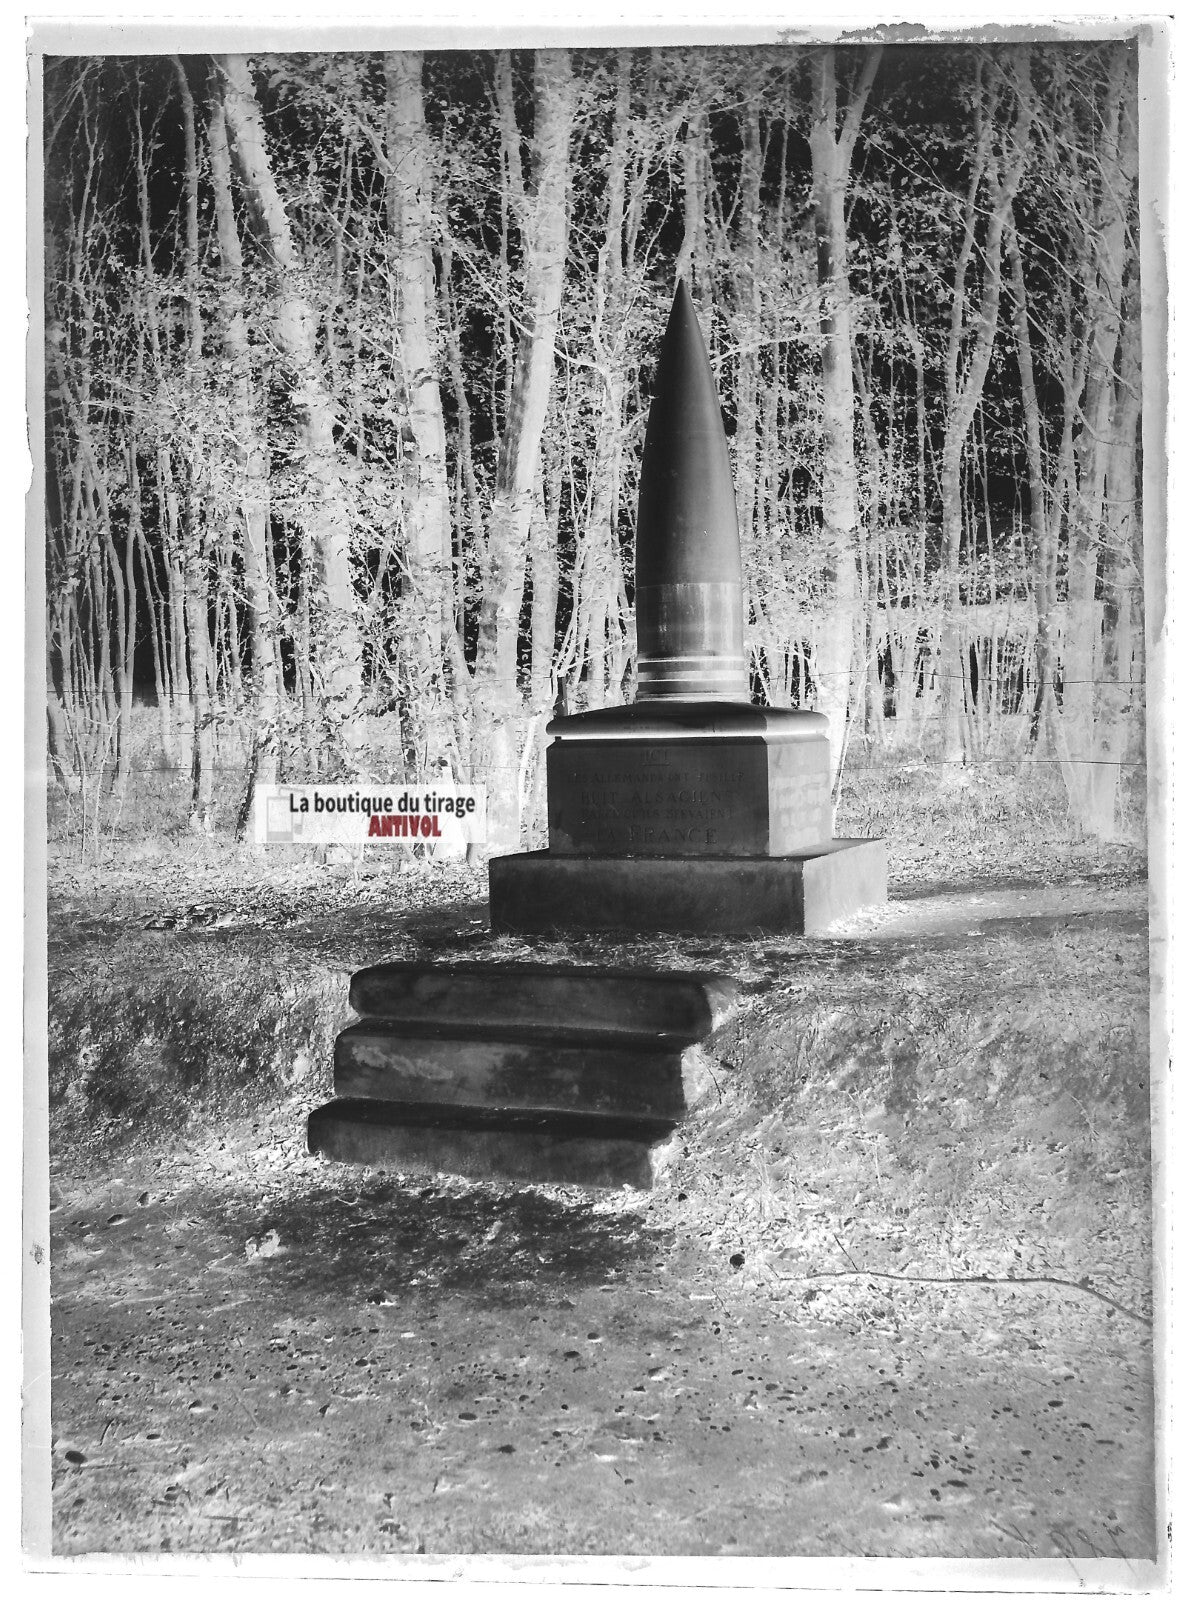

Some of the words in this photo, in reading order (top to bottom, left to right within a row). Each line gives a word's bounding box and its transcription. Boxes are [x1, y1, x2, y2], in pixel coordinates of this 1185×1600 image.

[581, 791, 617, 804] HUIT
[597, 829, 616, 842] LA
[629, 825, 717, 845] FRANCE
